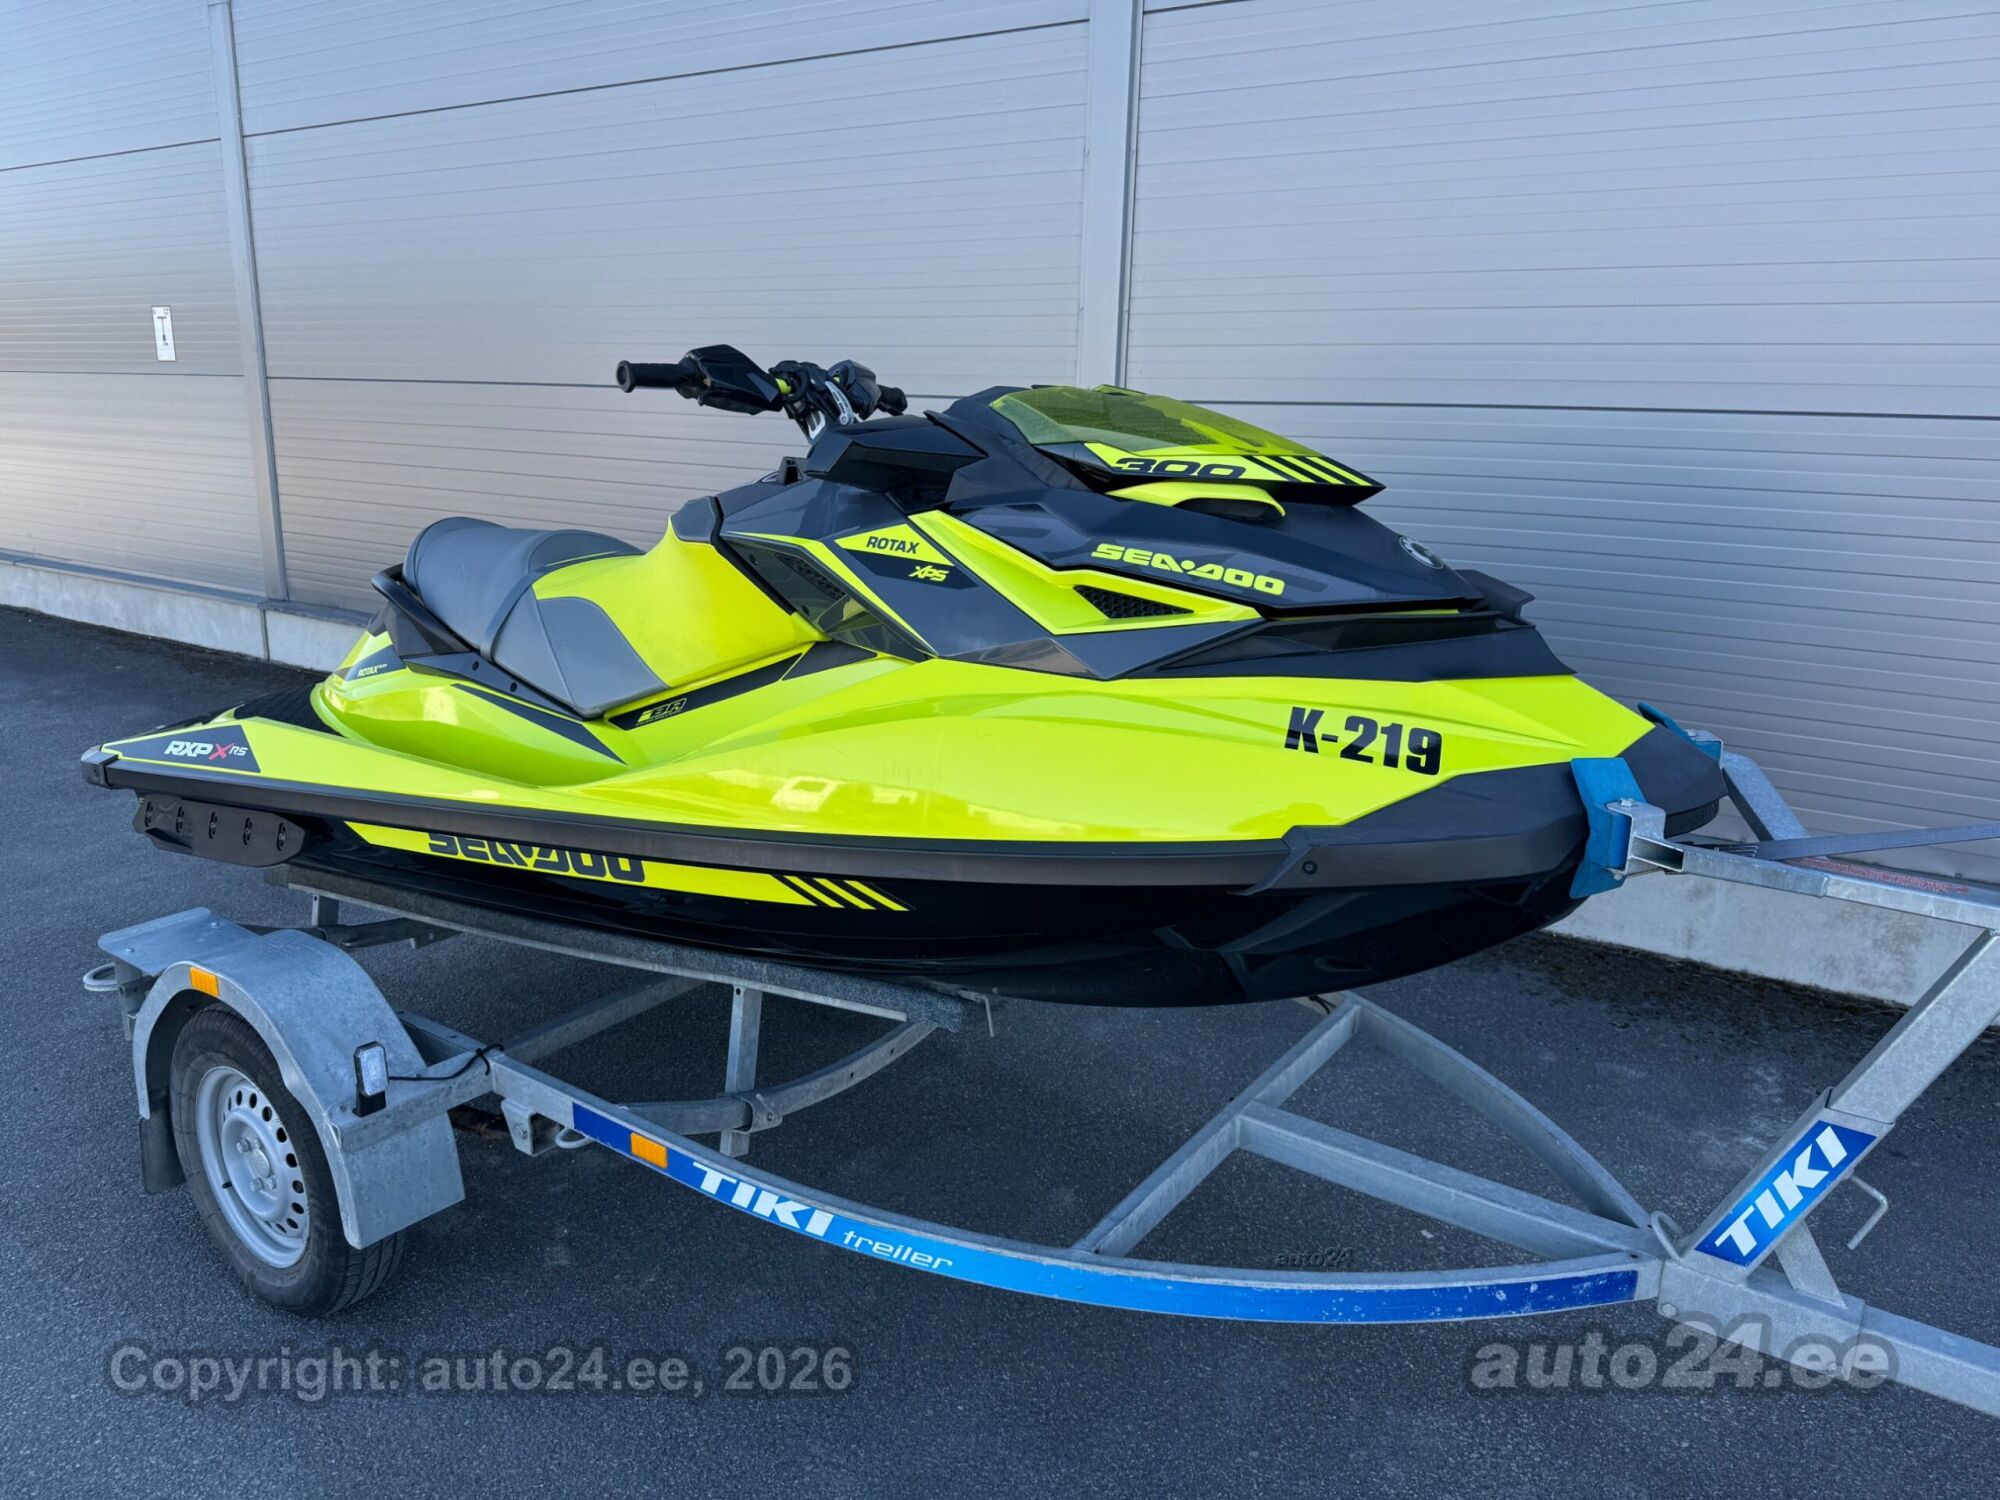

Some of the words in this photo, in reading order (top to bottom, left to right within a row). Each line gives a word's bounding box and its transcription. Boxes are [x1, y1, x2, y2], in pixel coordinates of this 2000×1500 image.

[1116, 457, 1247, 478] 300
[866, 536, 920, 554] ROTAX
[908, 565, 950, 582] XPS
[164, 740, 214, 757] RXP
[229, 745, 249, 757] RS
[1284, 706, 1443, 776] K-219
[1714, 1125, 1848, 1257] TIKI
[692, 1161, 835, 1237] TIKI
[843, 1230, 953, 1270] treiler
